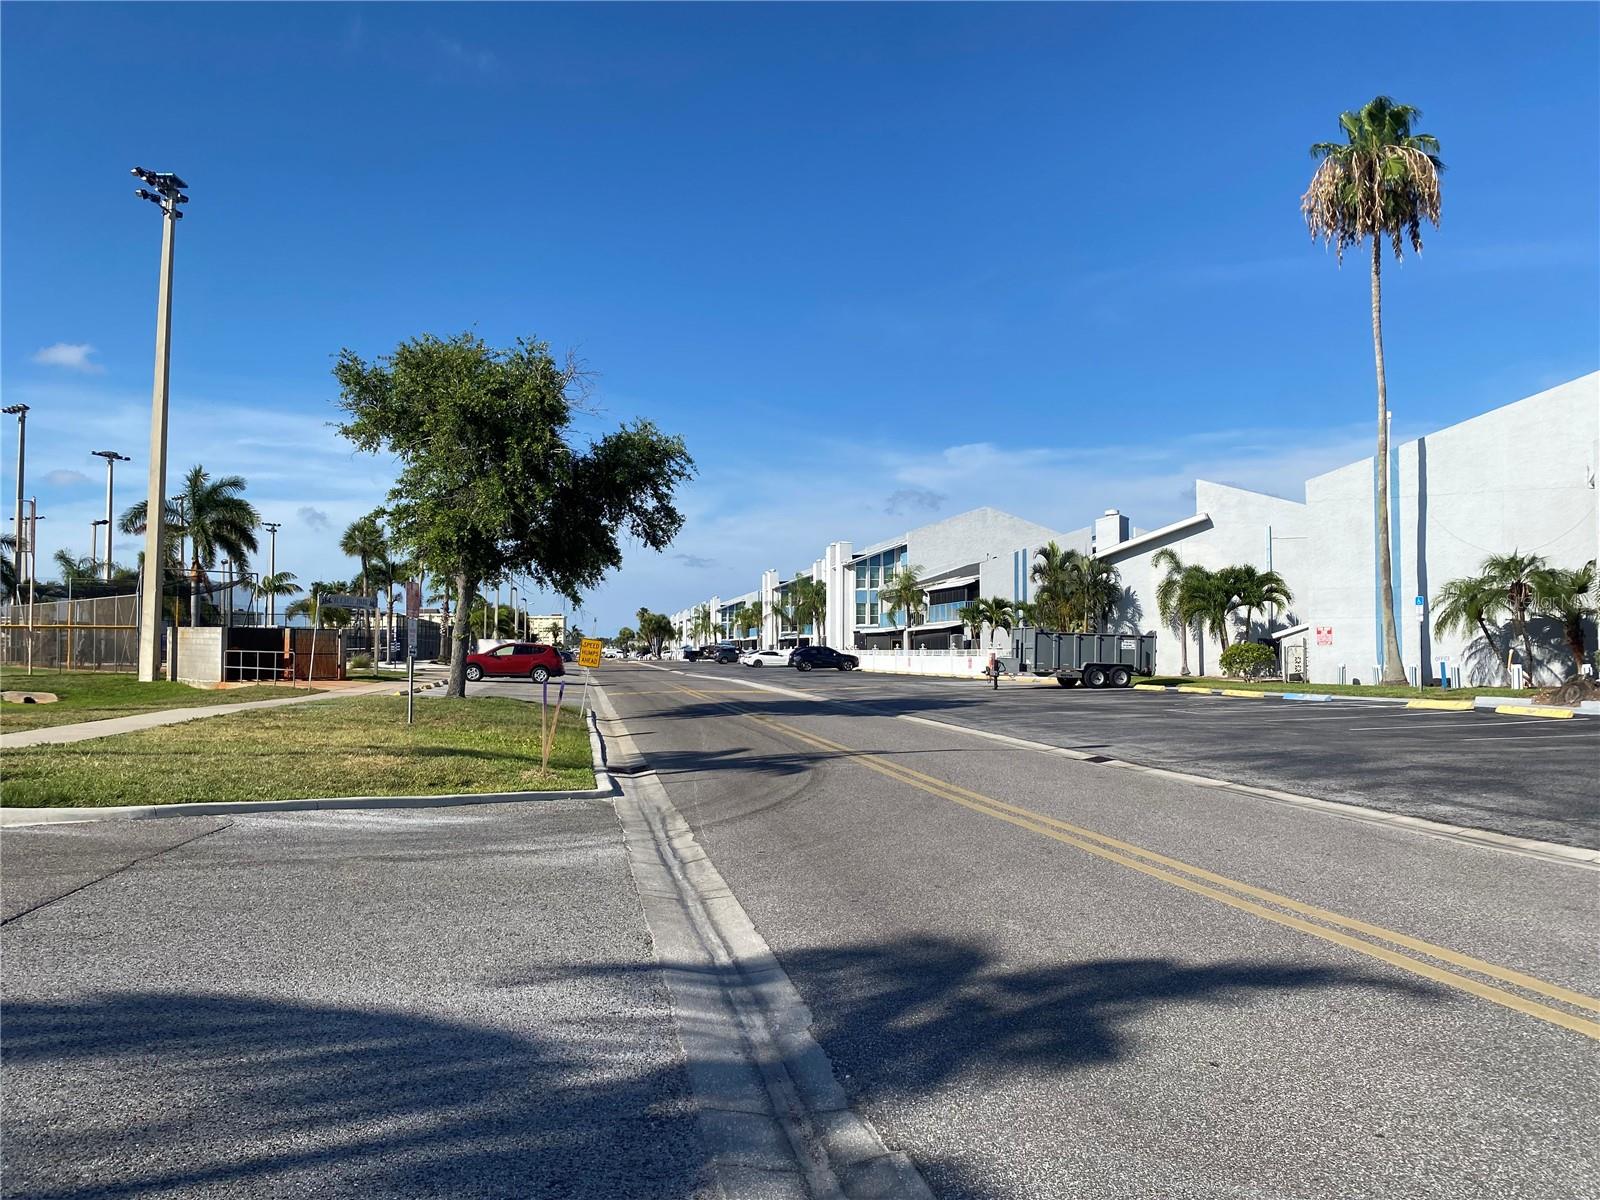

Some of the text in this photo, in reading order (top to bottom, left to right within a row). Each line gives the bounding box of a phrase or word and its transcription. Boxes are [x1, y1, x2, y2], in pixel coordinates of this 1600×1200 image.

[583, 641, 600, 649] SPEED
[582, 649, 599, 657] HUMPS
[581, 657, 598, 665] AHEAD
